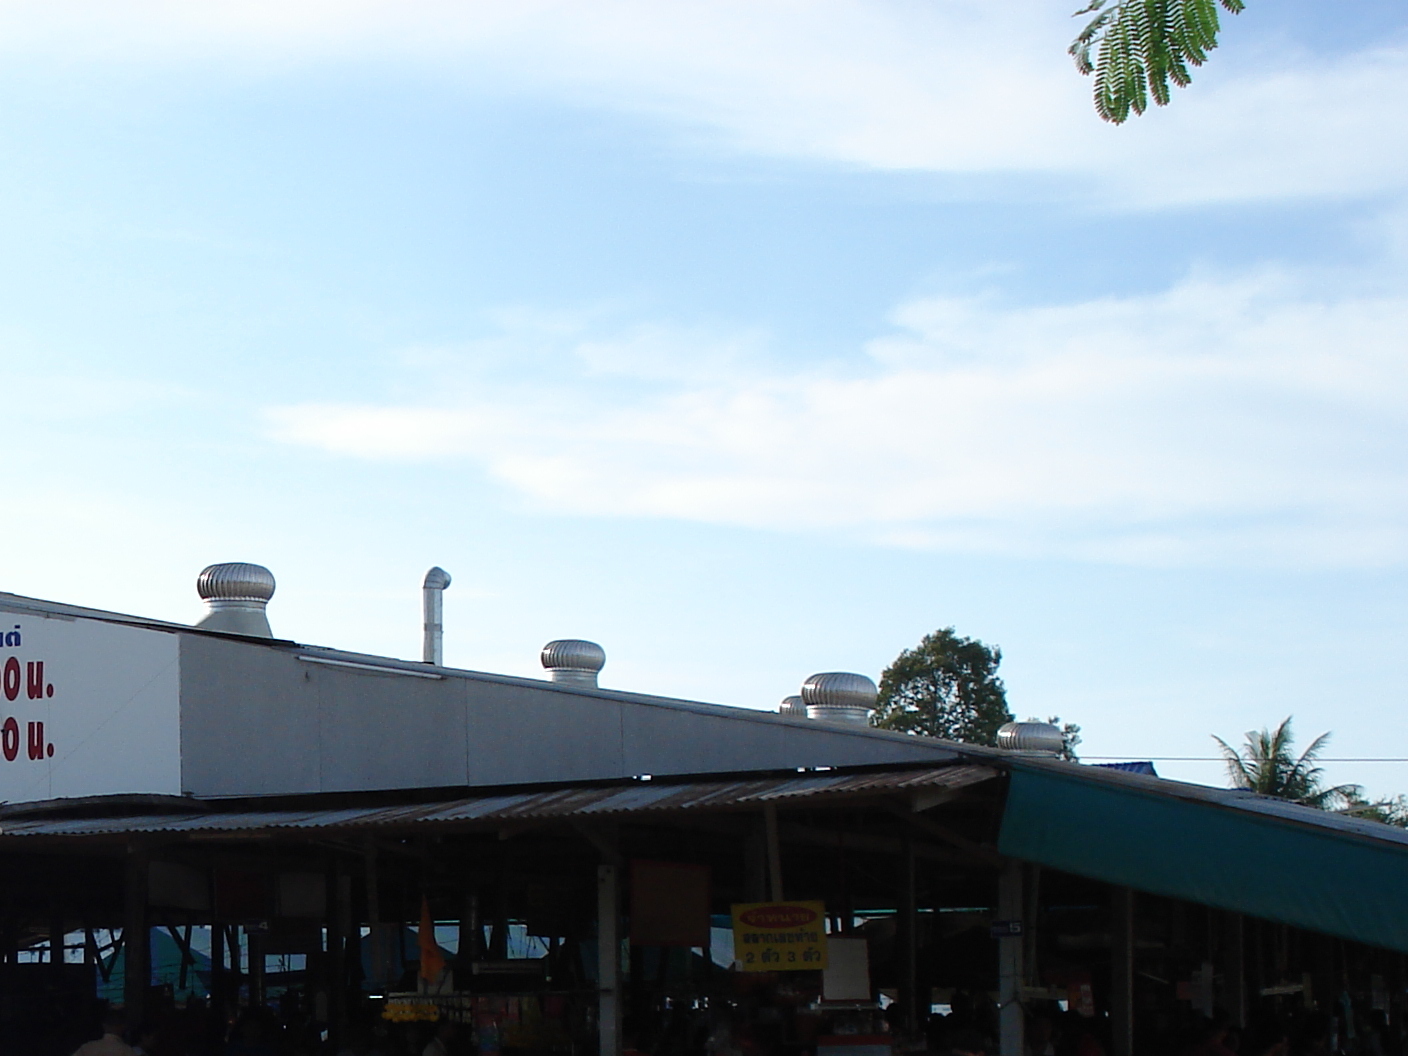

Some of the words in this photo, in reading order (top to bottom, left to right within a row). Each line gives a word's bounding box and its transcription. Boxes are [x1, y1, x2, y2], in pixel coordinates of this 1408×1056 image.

[27, 660, 54, 700] น.
[27, 721, 55, 760] น.
[745, 951, 755, 963] 2
[761, 948, 780, 963] ตัว
[787, 951, 796, 962] 3
[803, 947, 821, 962] ตัว
